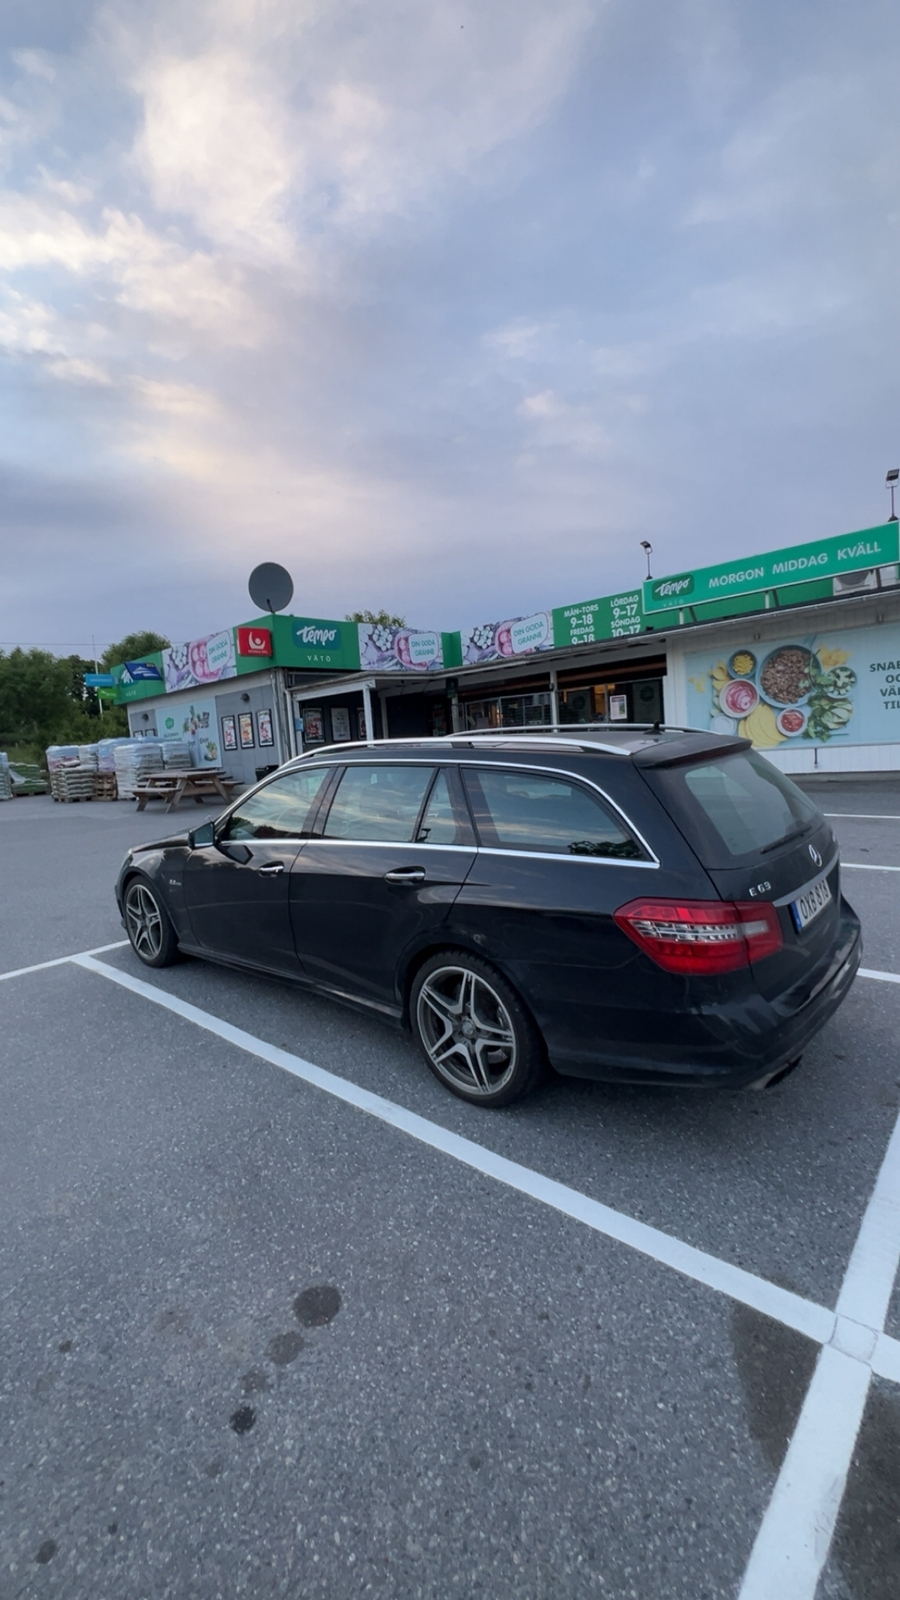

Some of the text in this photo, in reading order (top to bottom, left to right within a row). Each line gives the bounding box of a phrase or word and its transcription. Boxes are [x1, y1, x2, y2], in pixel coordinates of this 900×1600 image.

[708, 541, 882, 589] MORGON MIDDAG KVÄLL
[610, 595, 639, 607] LÖRDAG
[610, 616, 641, 628] SÖNDAG
[513, 621, 544, 637] DIN GODA
[570, 625, 595, 636] FREDAG
[517, 632, 543, 645] GRANNE
[307, 655, 331, 663] VÄTÖ
[414, 649, 436, 657] GRANNE
[748, 881, 772, 897] E 63
